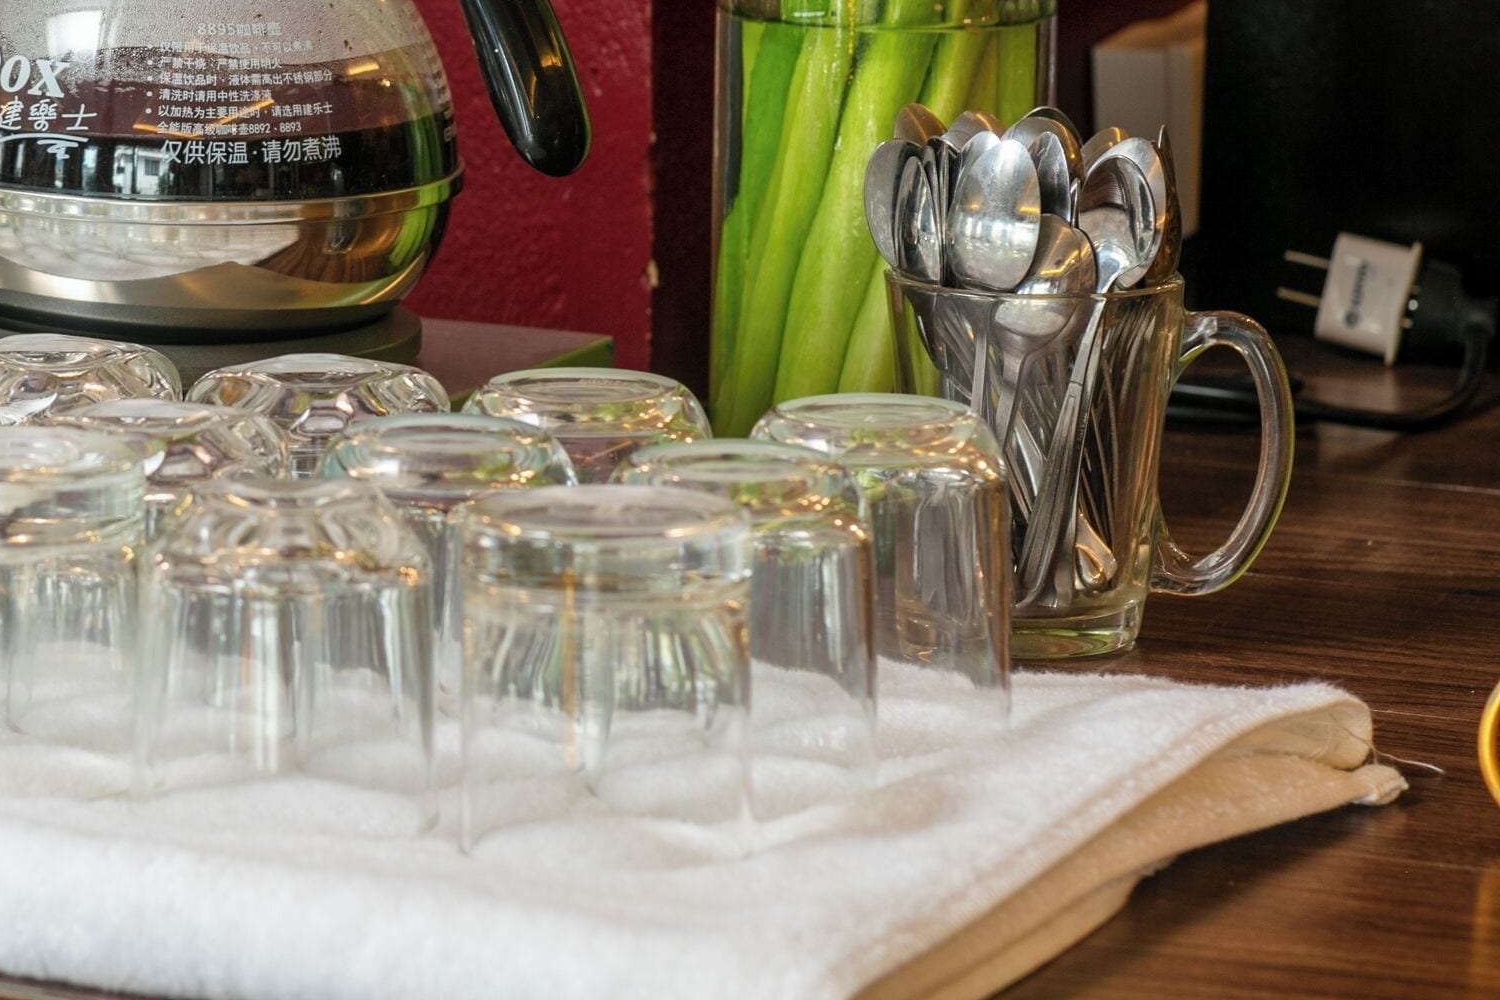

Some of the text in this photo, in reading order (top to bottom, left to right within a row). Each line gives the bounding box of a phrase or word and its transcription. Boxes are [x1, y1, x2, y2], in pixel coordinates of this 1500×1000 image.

[158, 88, 273, 103] 清洗时请用中性洗涤液
